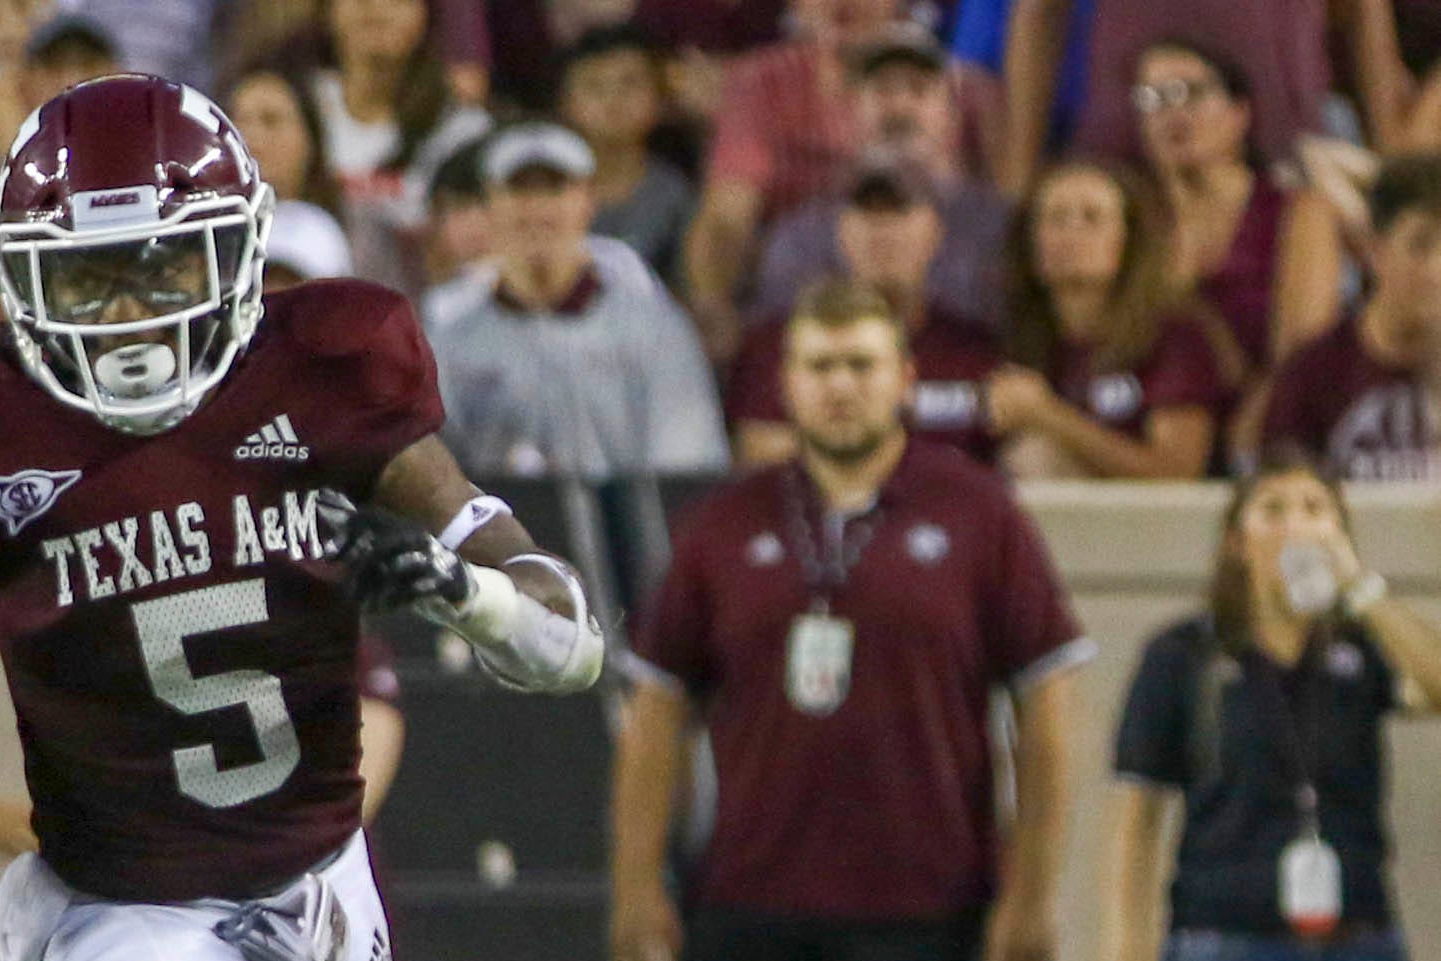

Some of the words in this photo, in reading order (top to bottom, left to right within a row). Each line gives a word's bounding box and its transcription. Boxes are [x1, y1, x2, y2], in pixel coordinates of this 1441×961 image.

[235, 442, 310, 460] adidas
[42, 502, 212, 607] TEXAS
[234, 489, 324, 563] A&M
[130, 577, 301, 808] 5
